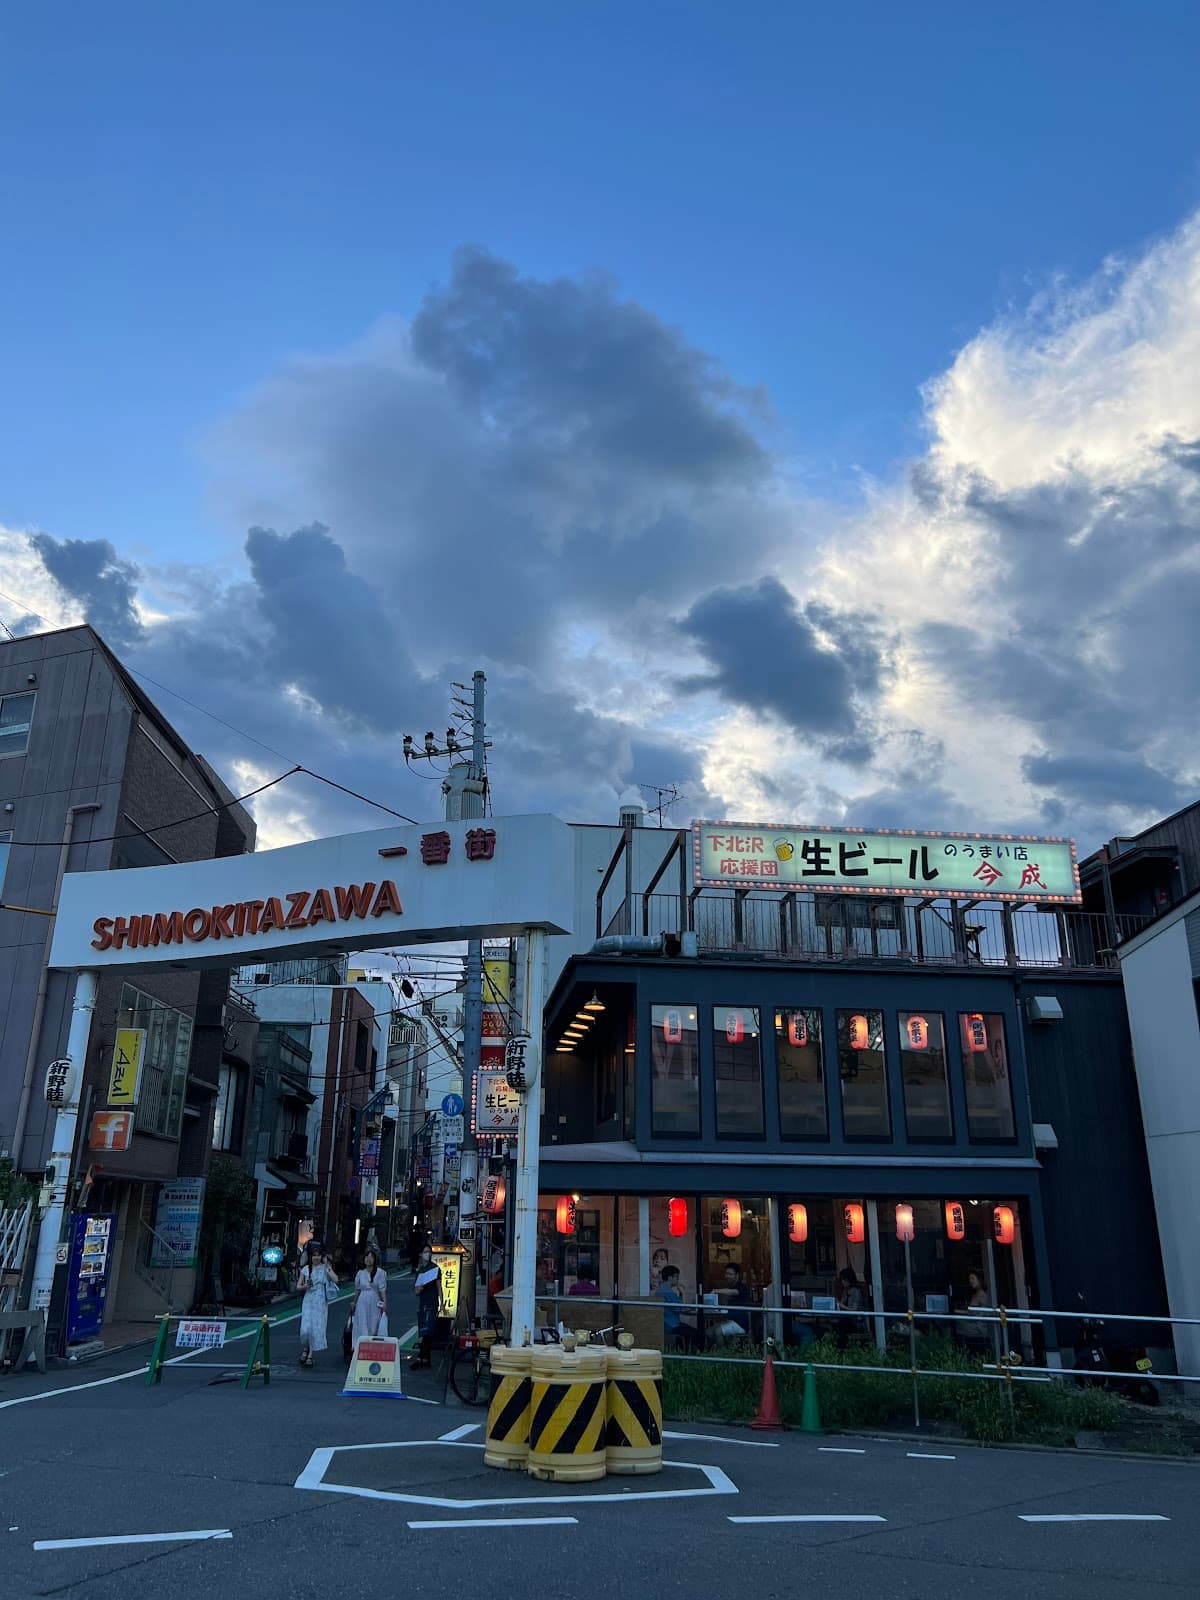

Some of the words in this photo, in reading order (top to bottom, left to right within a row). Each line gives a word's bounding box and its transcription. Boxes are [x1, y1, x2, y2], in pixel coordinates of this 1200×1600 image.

[379, 828, 496, 865] 一番街
[706, 835, 764, 853] 下北沢
[944, 844, 1028, 861] のうまい店
[720, 858, 779, 876] 応援団
[801, 838, 940, 881] 生ビール
[973, 861, 1048, 889] 今成
[91, 880, 403, 950] SHIMOKITAZAWA
[485, 1093, 518, 1108] 生ビー
[445, 1270, 456, 1308] 生ビール
